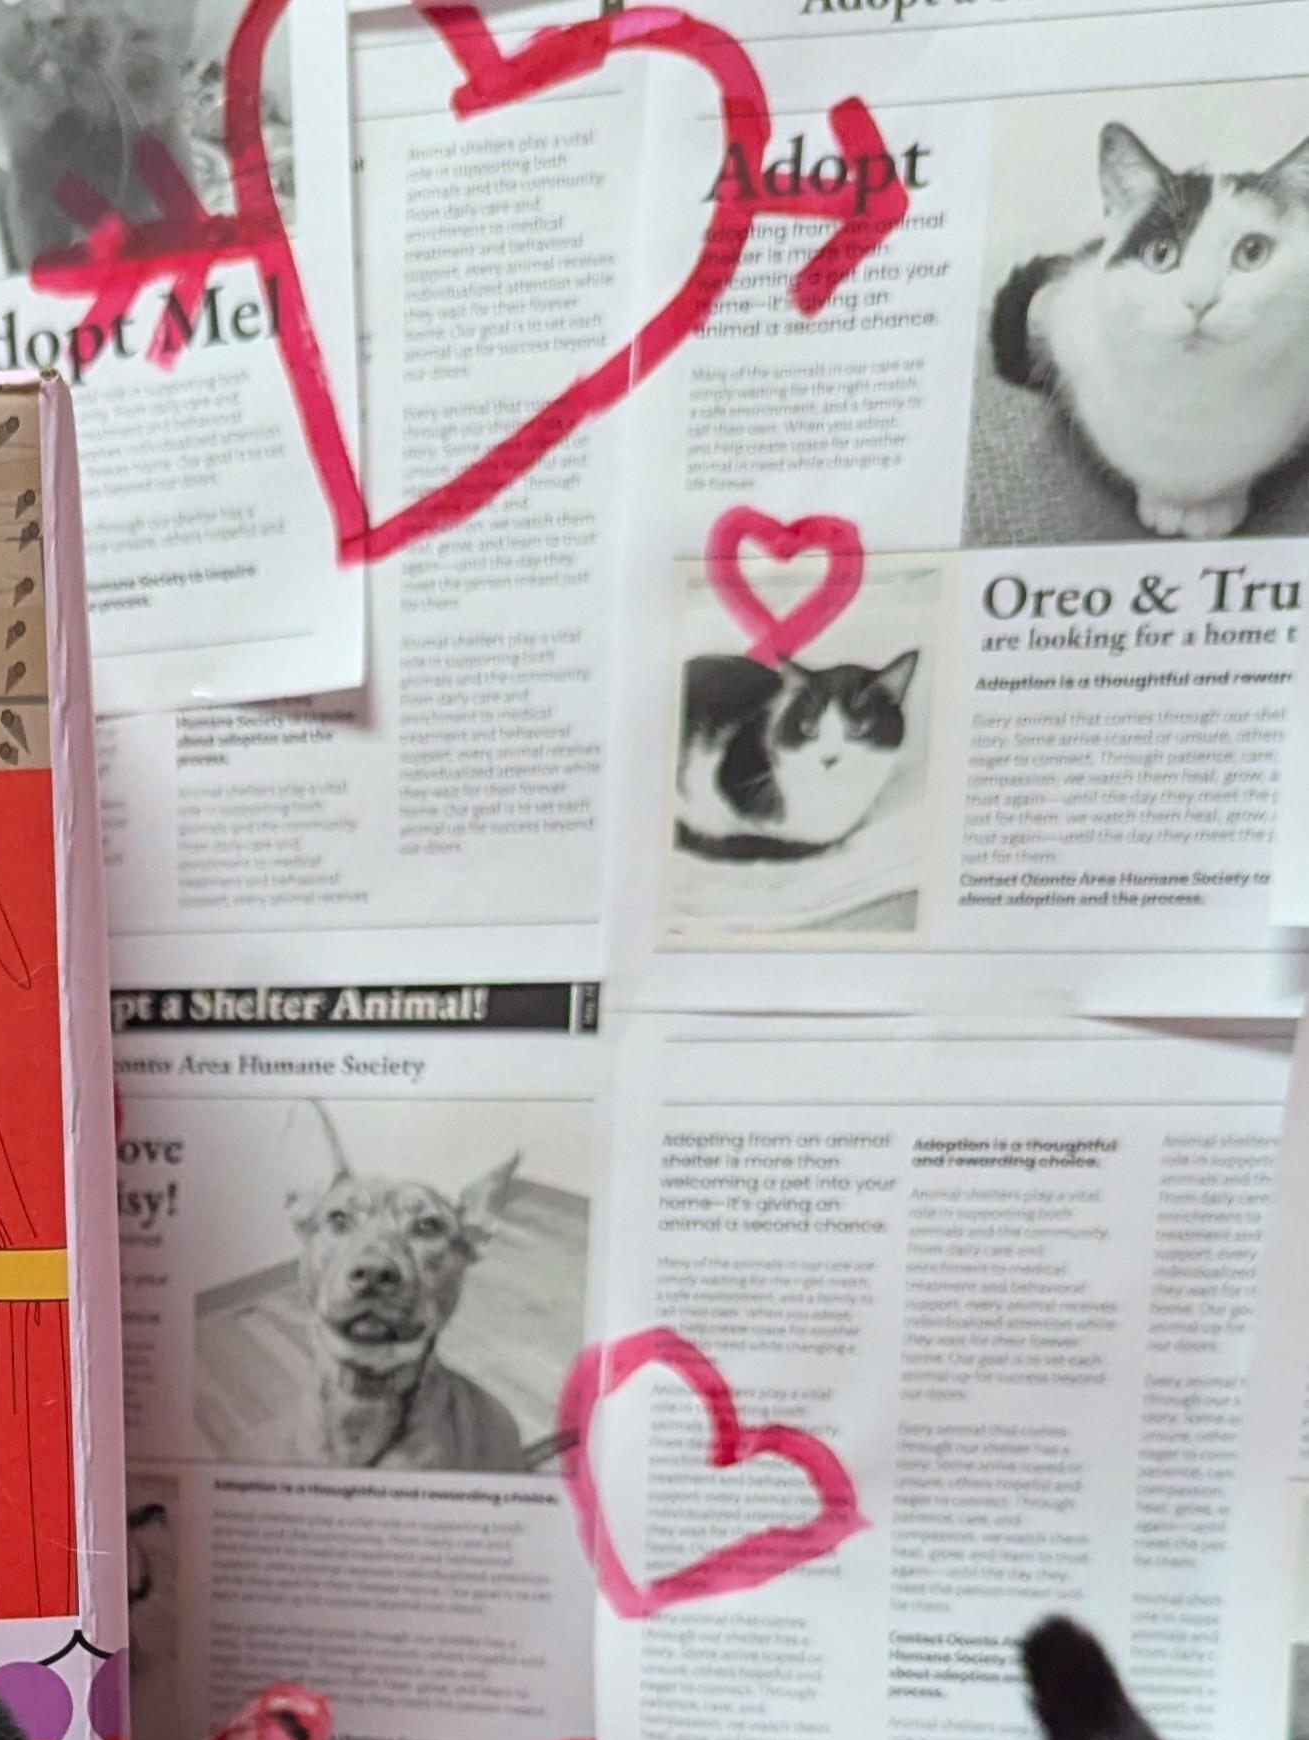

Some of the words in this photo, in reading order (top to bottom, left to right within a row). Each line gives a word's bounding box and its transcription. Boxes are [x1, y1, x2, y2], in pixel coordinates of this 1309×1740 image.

[702, 134, 930, 215] Adopt
[160, 273, 281, 354] Me!
[982, 576, 1112, 620] Oreo
[1130, 575, 1183, 616] &
[1201, 566, 1302, 613] Tru
[981, 634, 1020, 651] are
[1028, 624, 1128, 660] looking
[1134, 622, 1174, 646] for
[1182, 629, 1196, 645] a
[1204, 620, 1278, 644] home
[974, 674, 1056, 696] Adoption
[1058, 673, 1075, 688] is
[1077, 676, 1090, 688] a
[1093, 670, 1190, 693] thoughtful
[1192, 668, 1230, 684] and
[112, 990, 154, 1030] pt
[160, 992, 183, 1021] a
[190, 985, 325, 1021] Shelter
[329, 985, 490, 1021] Animal!
[661, 1133, 745, 1152] Adopting
[747, 1133, 792, 1148] from
[796, 1136, 821, 1148] an
[824, 1133, 891, 1148] animal
[660, 1153, 722, 1168] shelter
[725, 1153, 740, 1168] is
[743, 1156, 793, 1168] more
[797, 1153, 839, 1168] than
[660, 1175, 759, 1194] welcoming
[762, 1178, 776, 1190] a
[779, 1175, 811, 1195] pet
[815, 1176, 851, 1190] into
[855, 1179, 897, 1195] your
[755, 1196, 812, 1215] giving
[815, 1199, 840, 1210] an
[658, 1216, 724, 1231] animal
[723, 1220, 738, 1231] a
[742, 1217, 810, 1232] second
[813, 1218, 888, 1232] chance.
